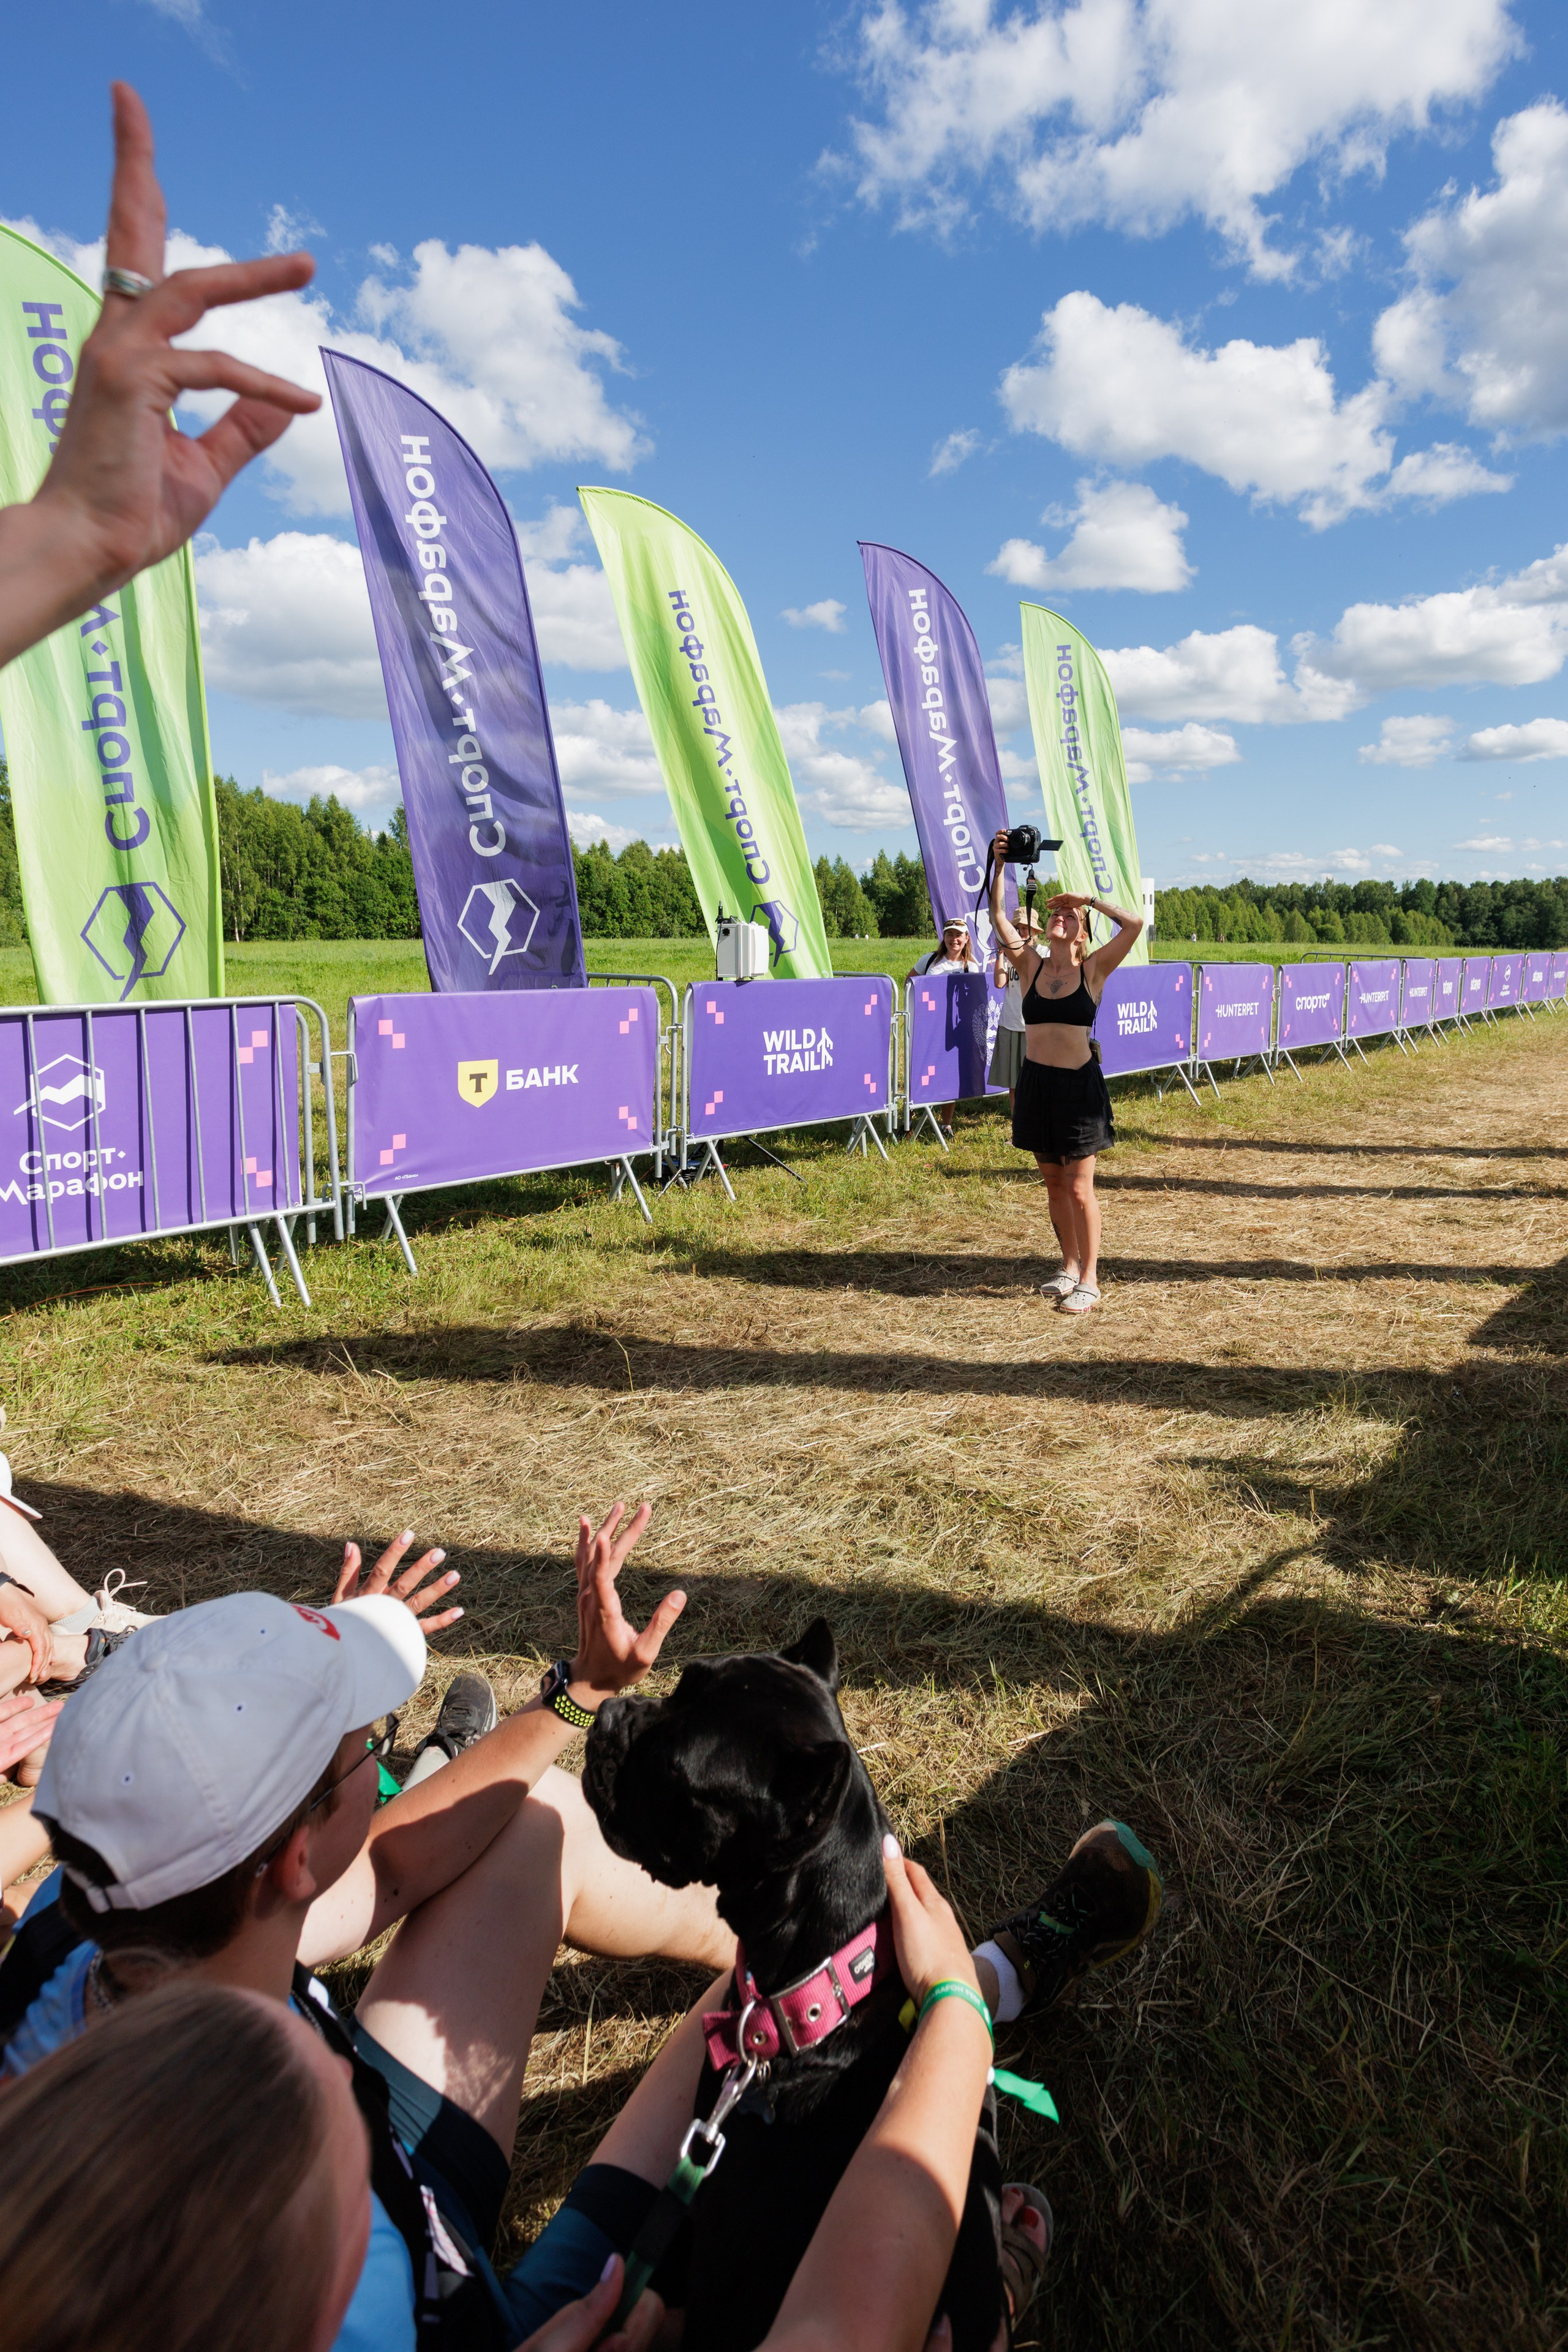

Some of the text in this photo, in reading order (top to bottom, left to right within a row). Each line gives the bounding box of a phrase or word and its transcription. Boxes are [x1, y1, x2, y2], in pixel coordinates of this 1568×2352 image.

[1117, 1001, 1148, 1019] WILD
[1215, 1002, 1259, 1018] HUNTERPET
[1117, 1017, 1152, 1036] TRAIL
[763, 1028, 816, 1052] WILD
[763, 1050, 821, 1076] TRAIL
[506, 1064, 579, 1091] БАНК
[0, 1170, 143, 1205] Марафон
